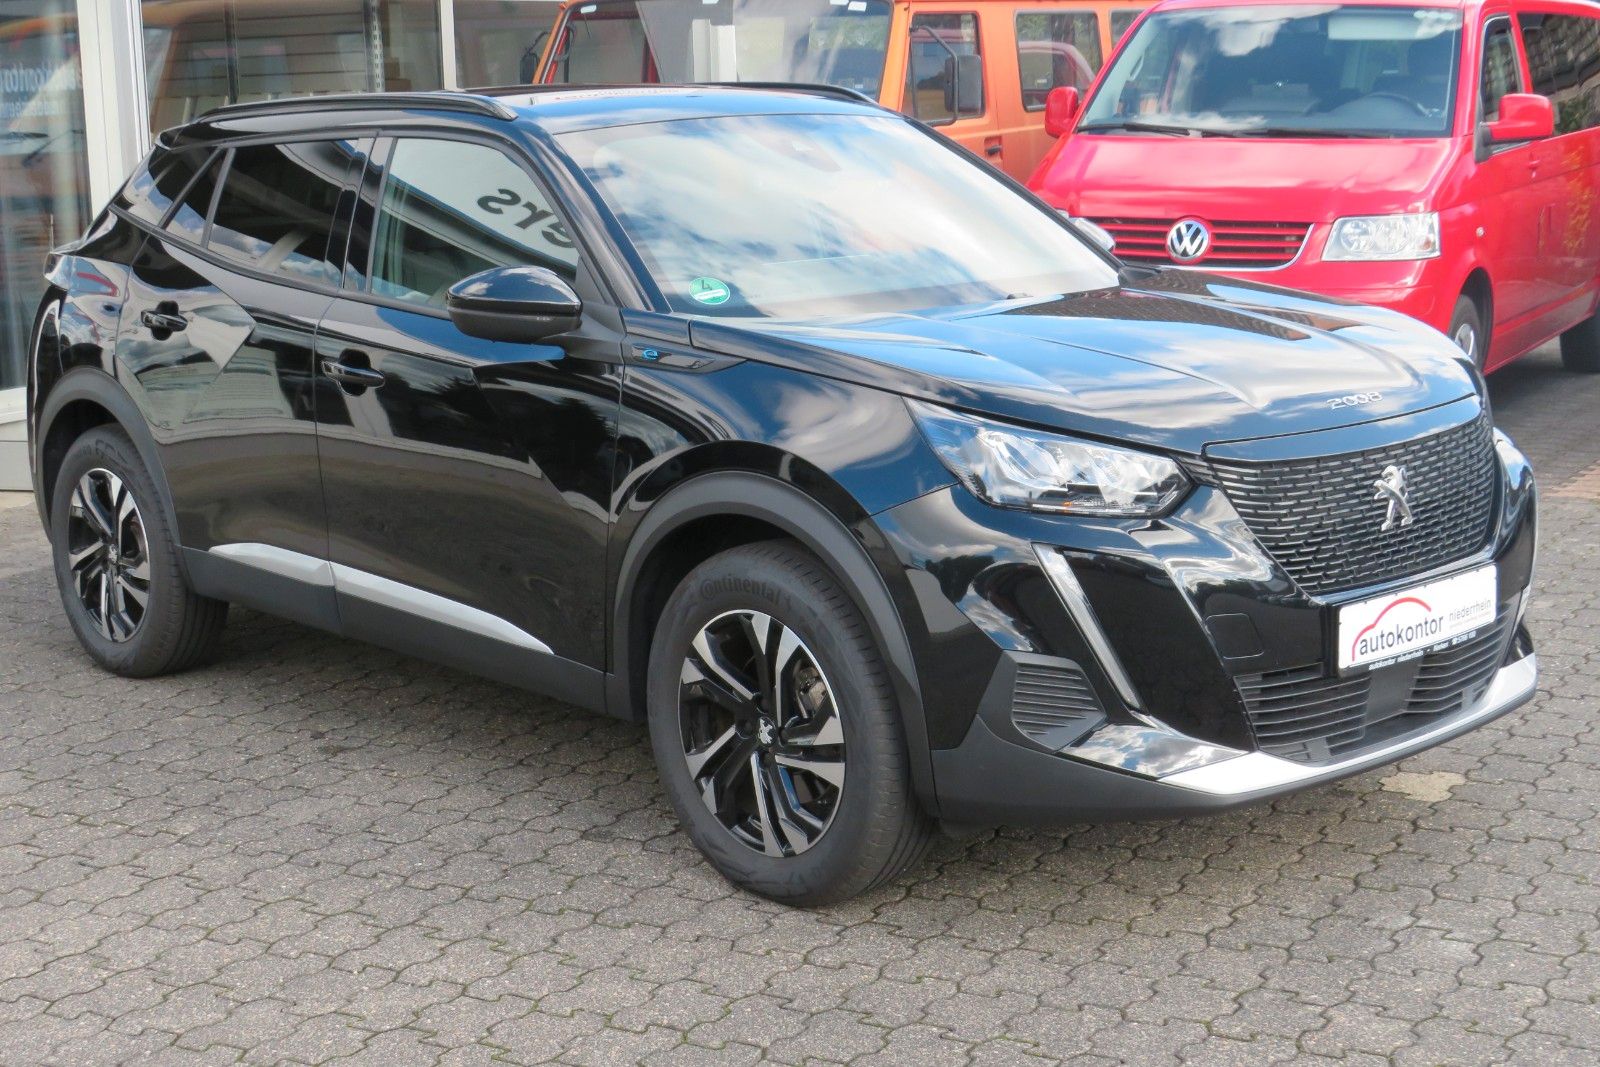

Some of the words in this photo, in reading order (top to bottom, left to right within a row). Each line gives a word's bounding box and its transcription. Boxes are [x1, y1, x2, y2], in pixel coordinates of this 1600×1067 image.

[1327, 391, 1383, 410] 2008
[1359, 616, 1444, 656] autokontor
[1449, 599, 1491, 621] niederrhein
